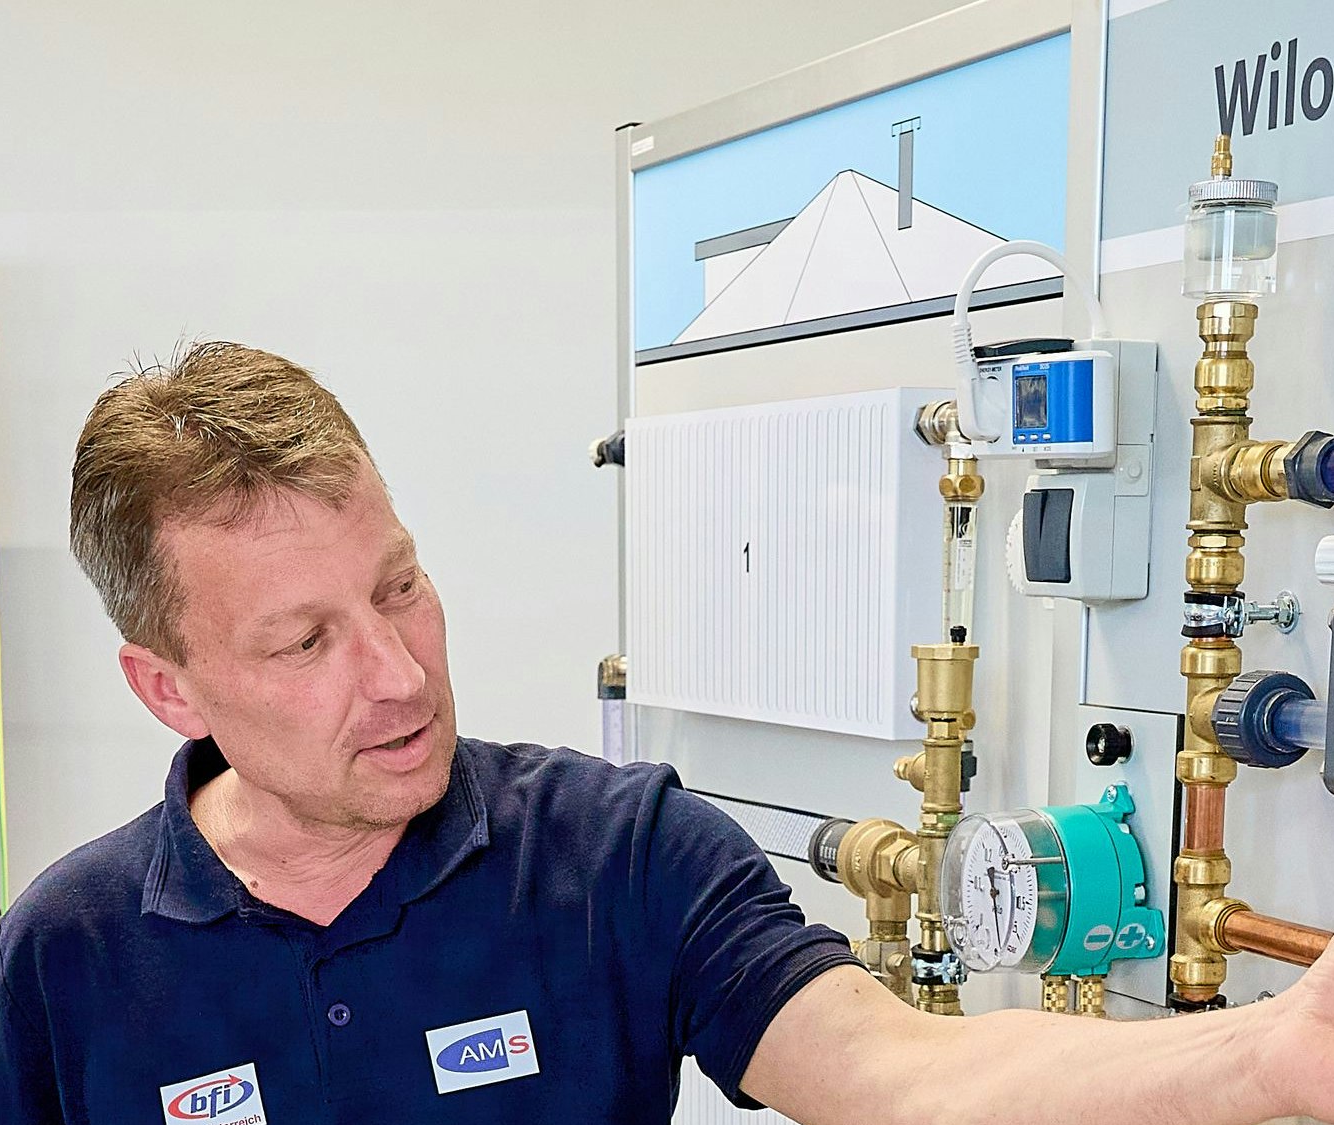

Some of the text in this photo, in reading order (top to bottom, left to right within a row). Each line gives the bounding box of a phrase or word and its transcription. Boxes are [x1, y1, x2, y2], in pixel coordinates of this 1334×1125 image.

[743, 541, 750, 573] 1
[459, 1034, 530, 1065] AMS
[190, 1084, 231, 1119] bfi
